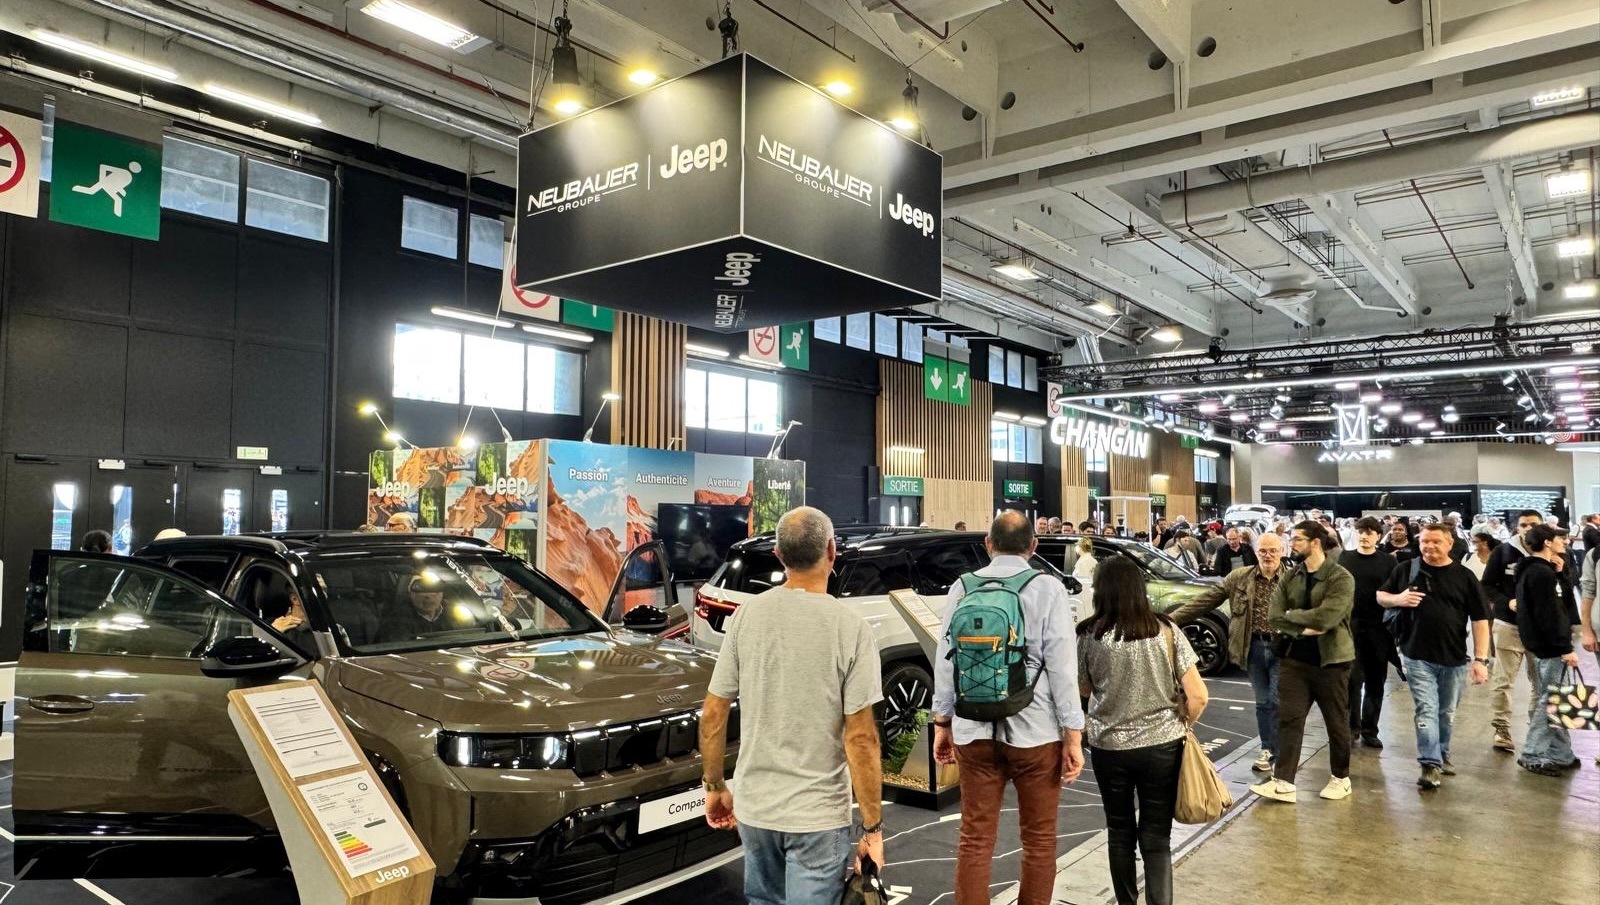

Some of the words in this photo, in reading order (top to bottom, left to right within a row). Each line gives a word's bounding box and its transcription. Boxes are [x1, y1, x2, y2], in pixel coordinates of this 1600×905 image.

[527, 162, 639, 212] NEUBAUER
[660, 138, 727, 179] Jeep
[758, 134, 873, 201] NEUBAUER
[888, 192, 934, 237] Jeep
[794, 172, 840, 199] GROUPE
[557, 193, 601, 213] GROUPE
[714, 252, 761, 286] Jeep
[1050, 415, 1150, 459] CHANGAN
[1318, 449, 1393, 463] AVATR
[569, 468, 608, 481] Passion
[635, 472, 688, 486] Authenticité
[707, 475, 742, 488] Aventure
[375, 475, 411, 501] Jeep
[485, 471, 529, 498] Jeep
[767, 478, 791, 490] Liberté
[889, 479, 918, 493] SORTIE
[1008, 482, 1029, 495] SORTIE
[656, 692, 682, 704] Jeep
[668, 797, 706, 815] Compas
[375, 865, 410, 884] Jeep
